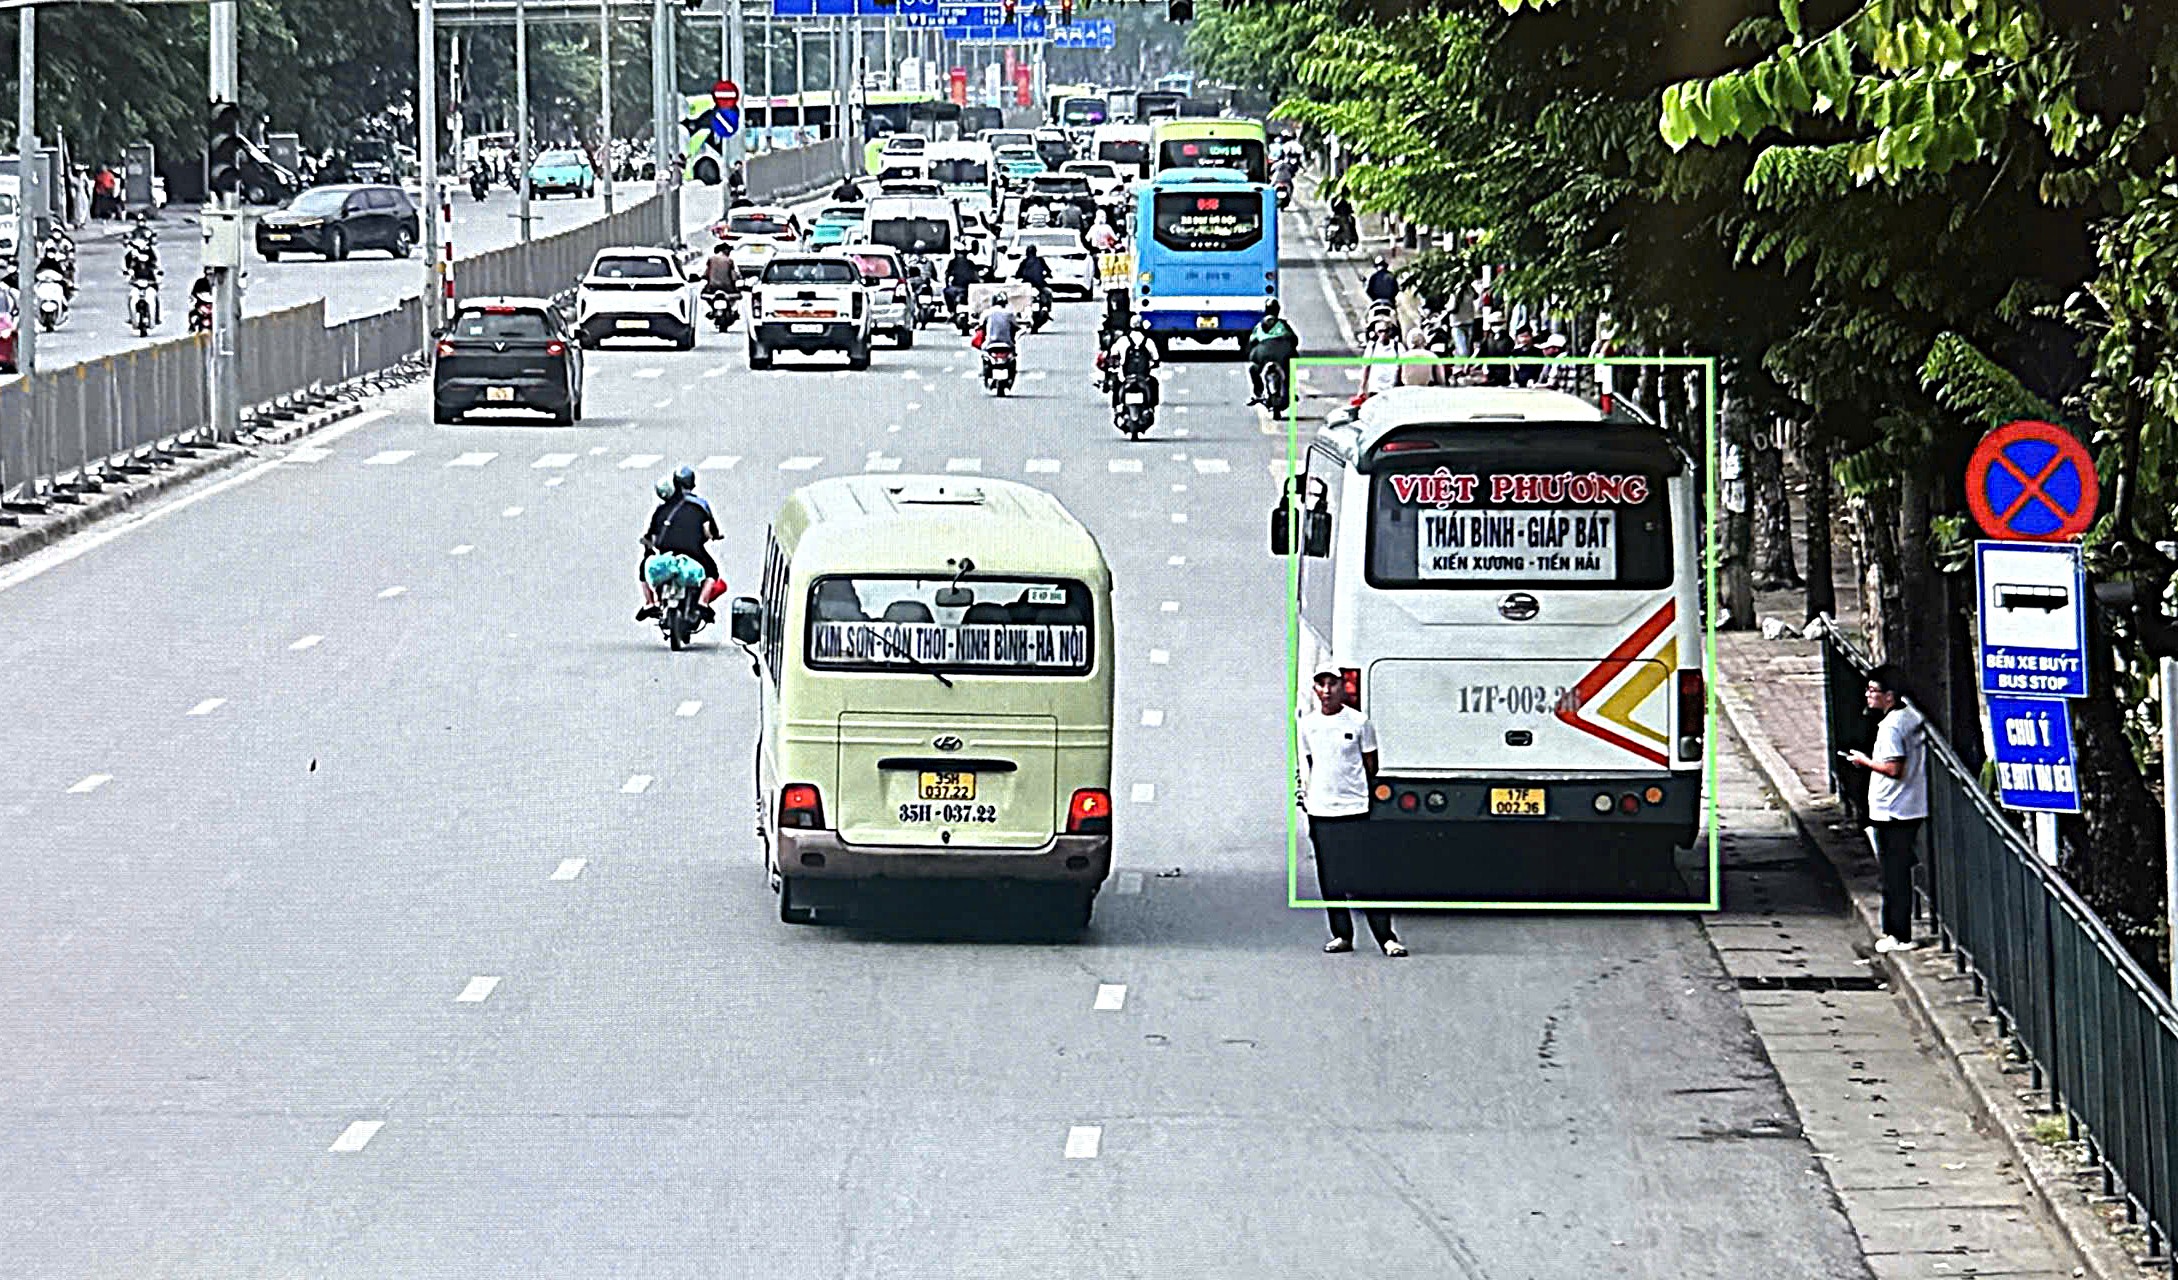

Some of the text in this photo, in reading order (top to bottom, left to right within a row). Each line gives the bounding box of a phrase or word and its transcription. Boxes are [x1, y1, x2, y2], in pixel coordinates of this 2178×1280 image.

[1390, 466, 1649, 508] VIỆT PHƯƠNG
[1425, 511, 1465, 548] THÁI
[1471, 510, 1514, 548] BÌNH
[1527, 510, 1569, 548] GIÁP
[1575, 511, 1610, 548] BÁT
[1575, 551, 1600, 571] HẢI
[814, 624, 842, 657] KIM
[1986, 648, 2079, 672] BẾN XE BUÝT
[1998, 674, 2068, 690] BUS STOP
[2005, 711, 2050, 747] CHÚ Ý
[934, 772, 960, 785] 35H
[925, 785, 969, 799] 037.22
[1507, 788, 1529, 800] 17F
[1496, 802, 1540, 814] 002.36
